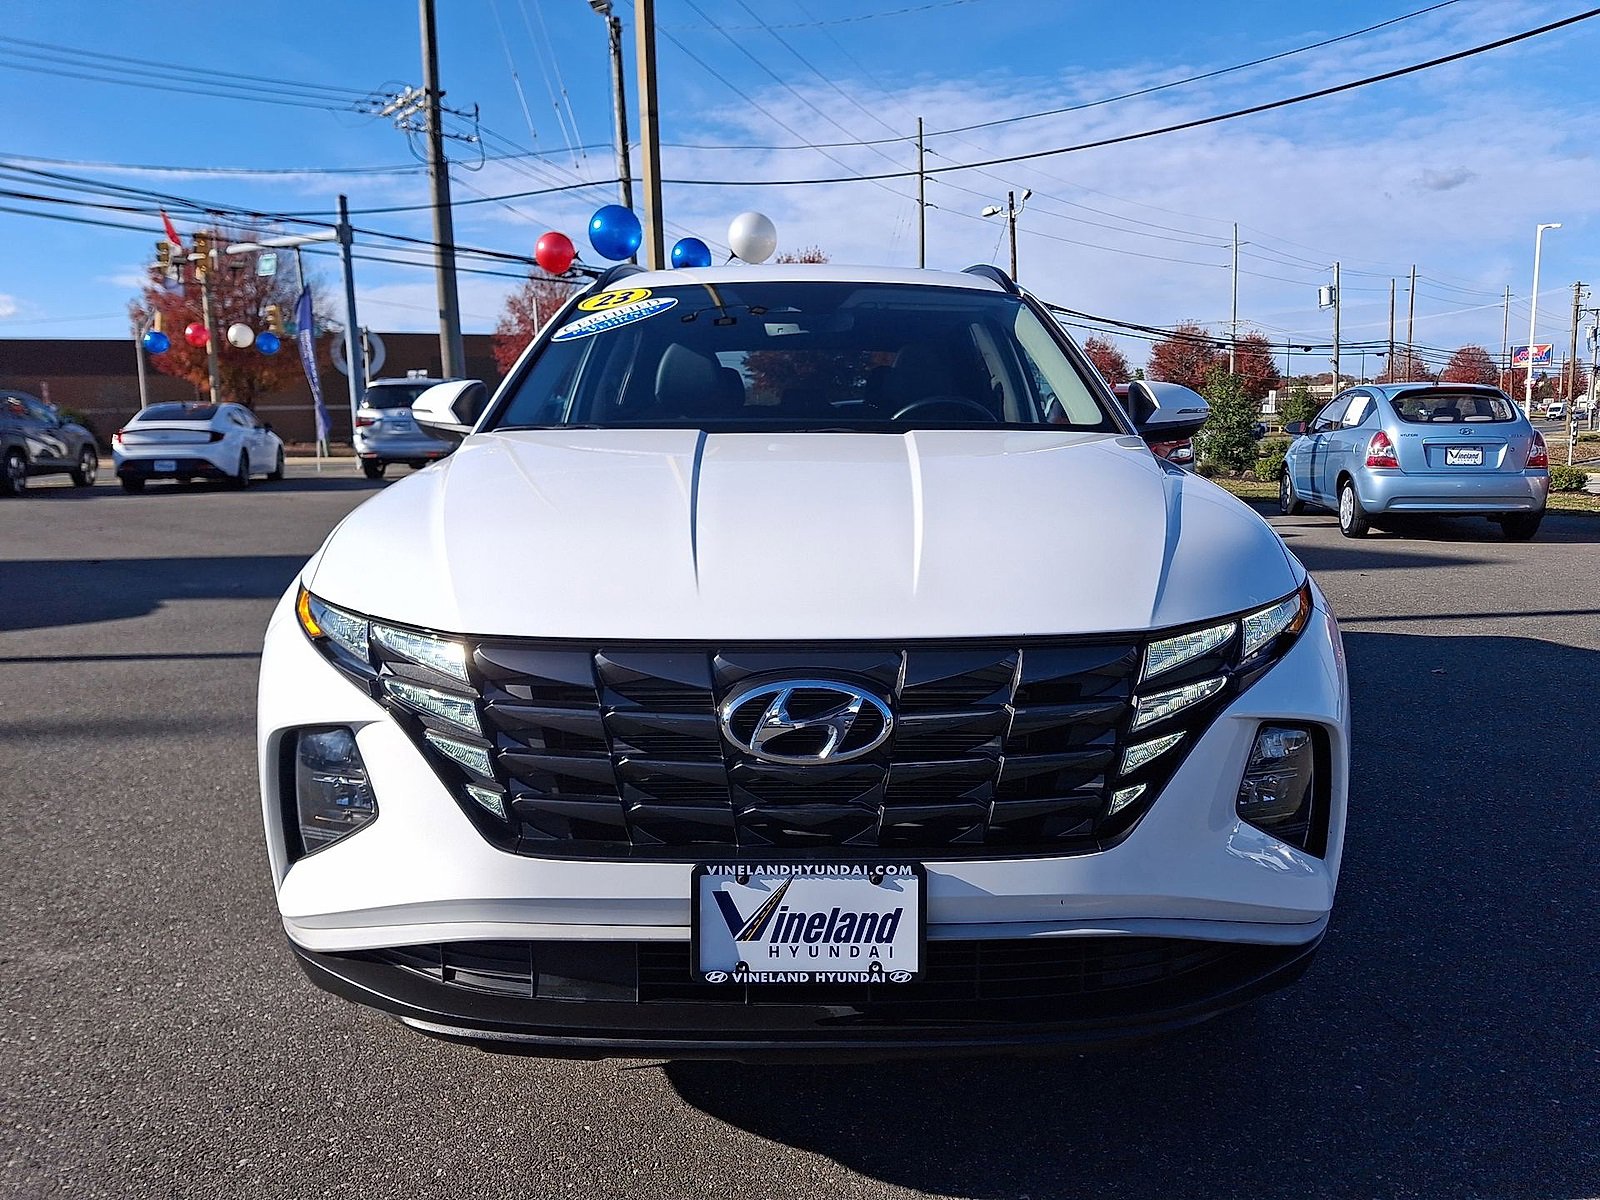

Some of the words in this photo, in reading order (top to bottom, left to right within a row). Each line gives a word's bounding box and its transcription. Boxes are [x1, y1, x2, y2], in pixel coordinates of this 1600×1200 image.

[593, 291, 634, 307] 23
[564, 299, 660, 332] CERTIFIED
[1448, 449, 1479, 459] Vineland
[706, 865, 913, 875] VINELANDHYUNDAI.COM
[711, 876, 904, 944] Vineland
[768, 945, 893, 958] HYUNDAI
[732, 972, 809, 983] VINELAND
[815, 972, 886, 983] HYUNDAI
